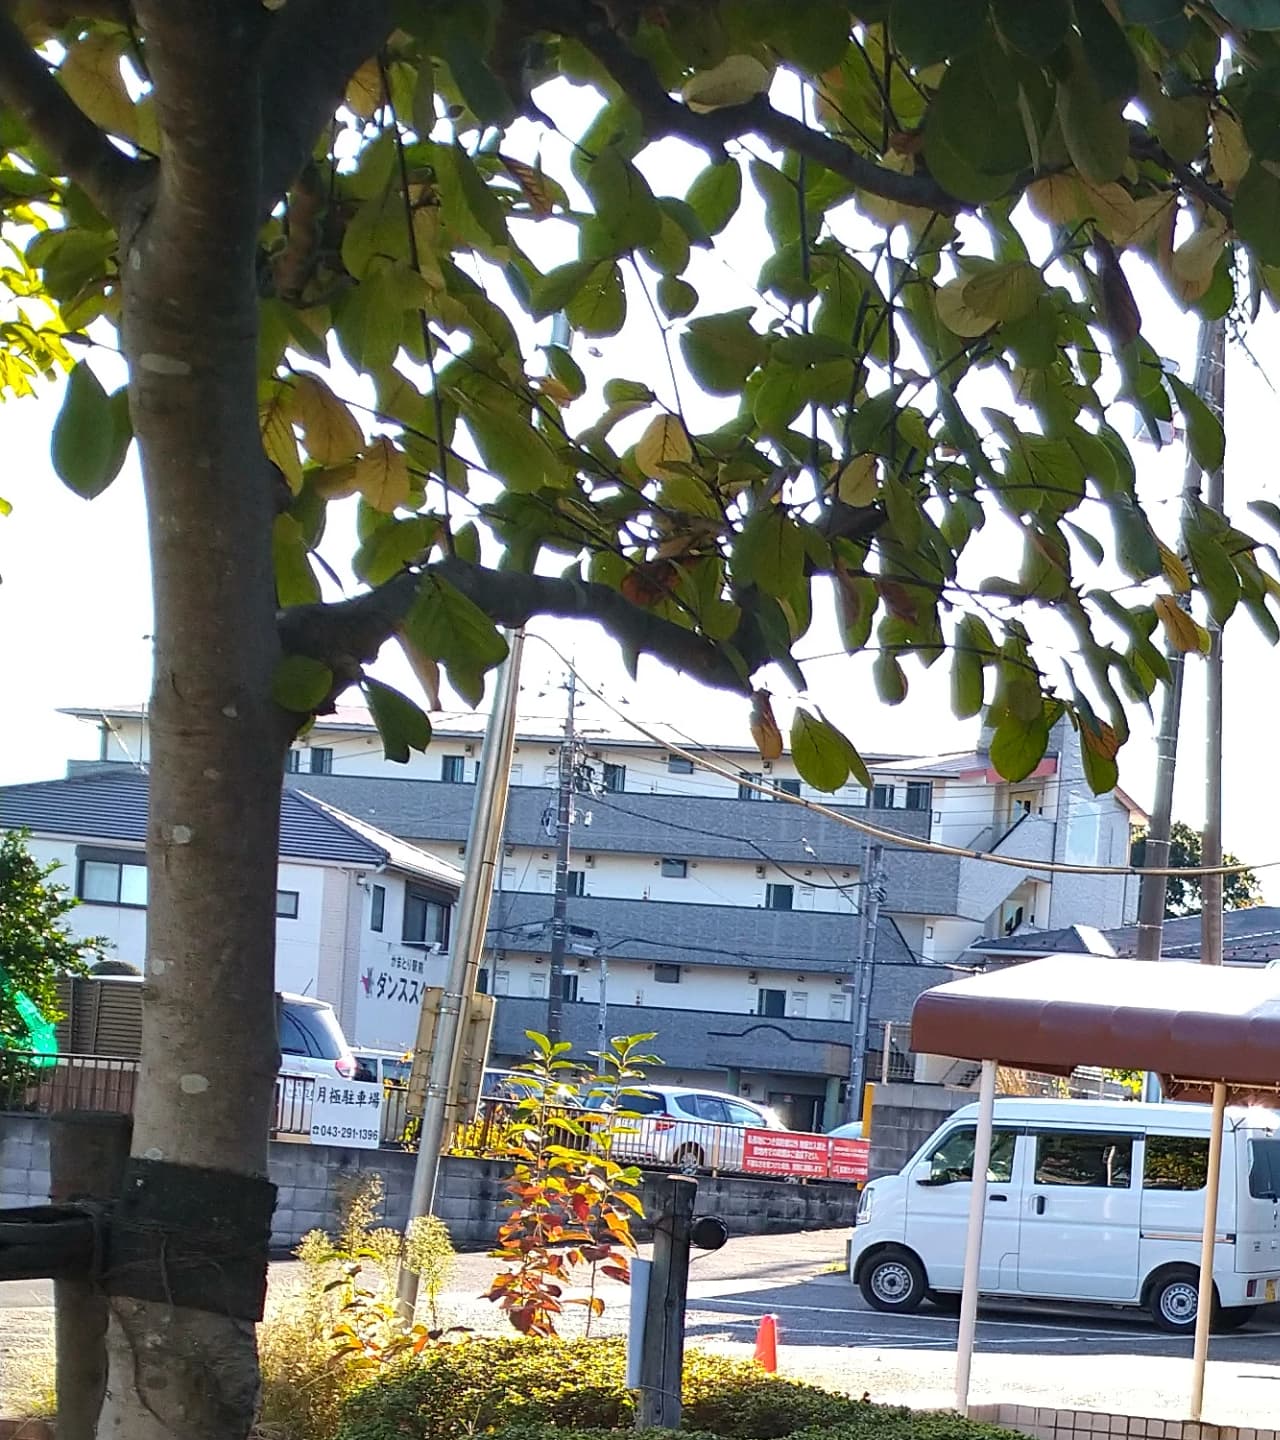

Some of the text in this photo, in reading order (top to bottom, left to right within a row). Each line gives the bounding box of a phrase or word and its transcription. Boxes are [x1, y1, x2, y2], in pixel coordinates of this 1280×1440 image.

[317, 1086, 380, 1108] 月極駐車場
